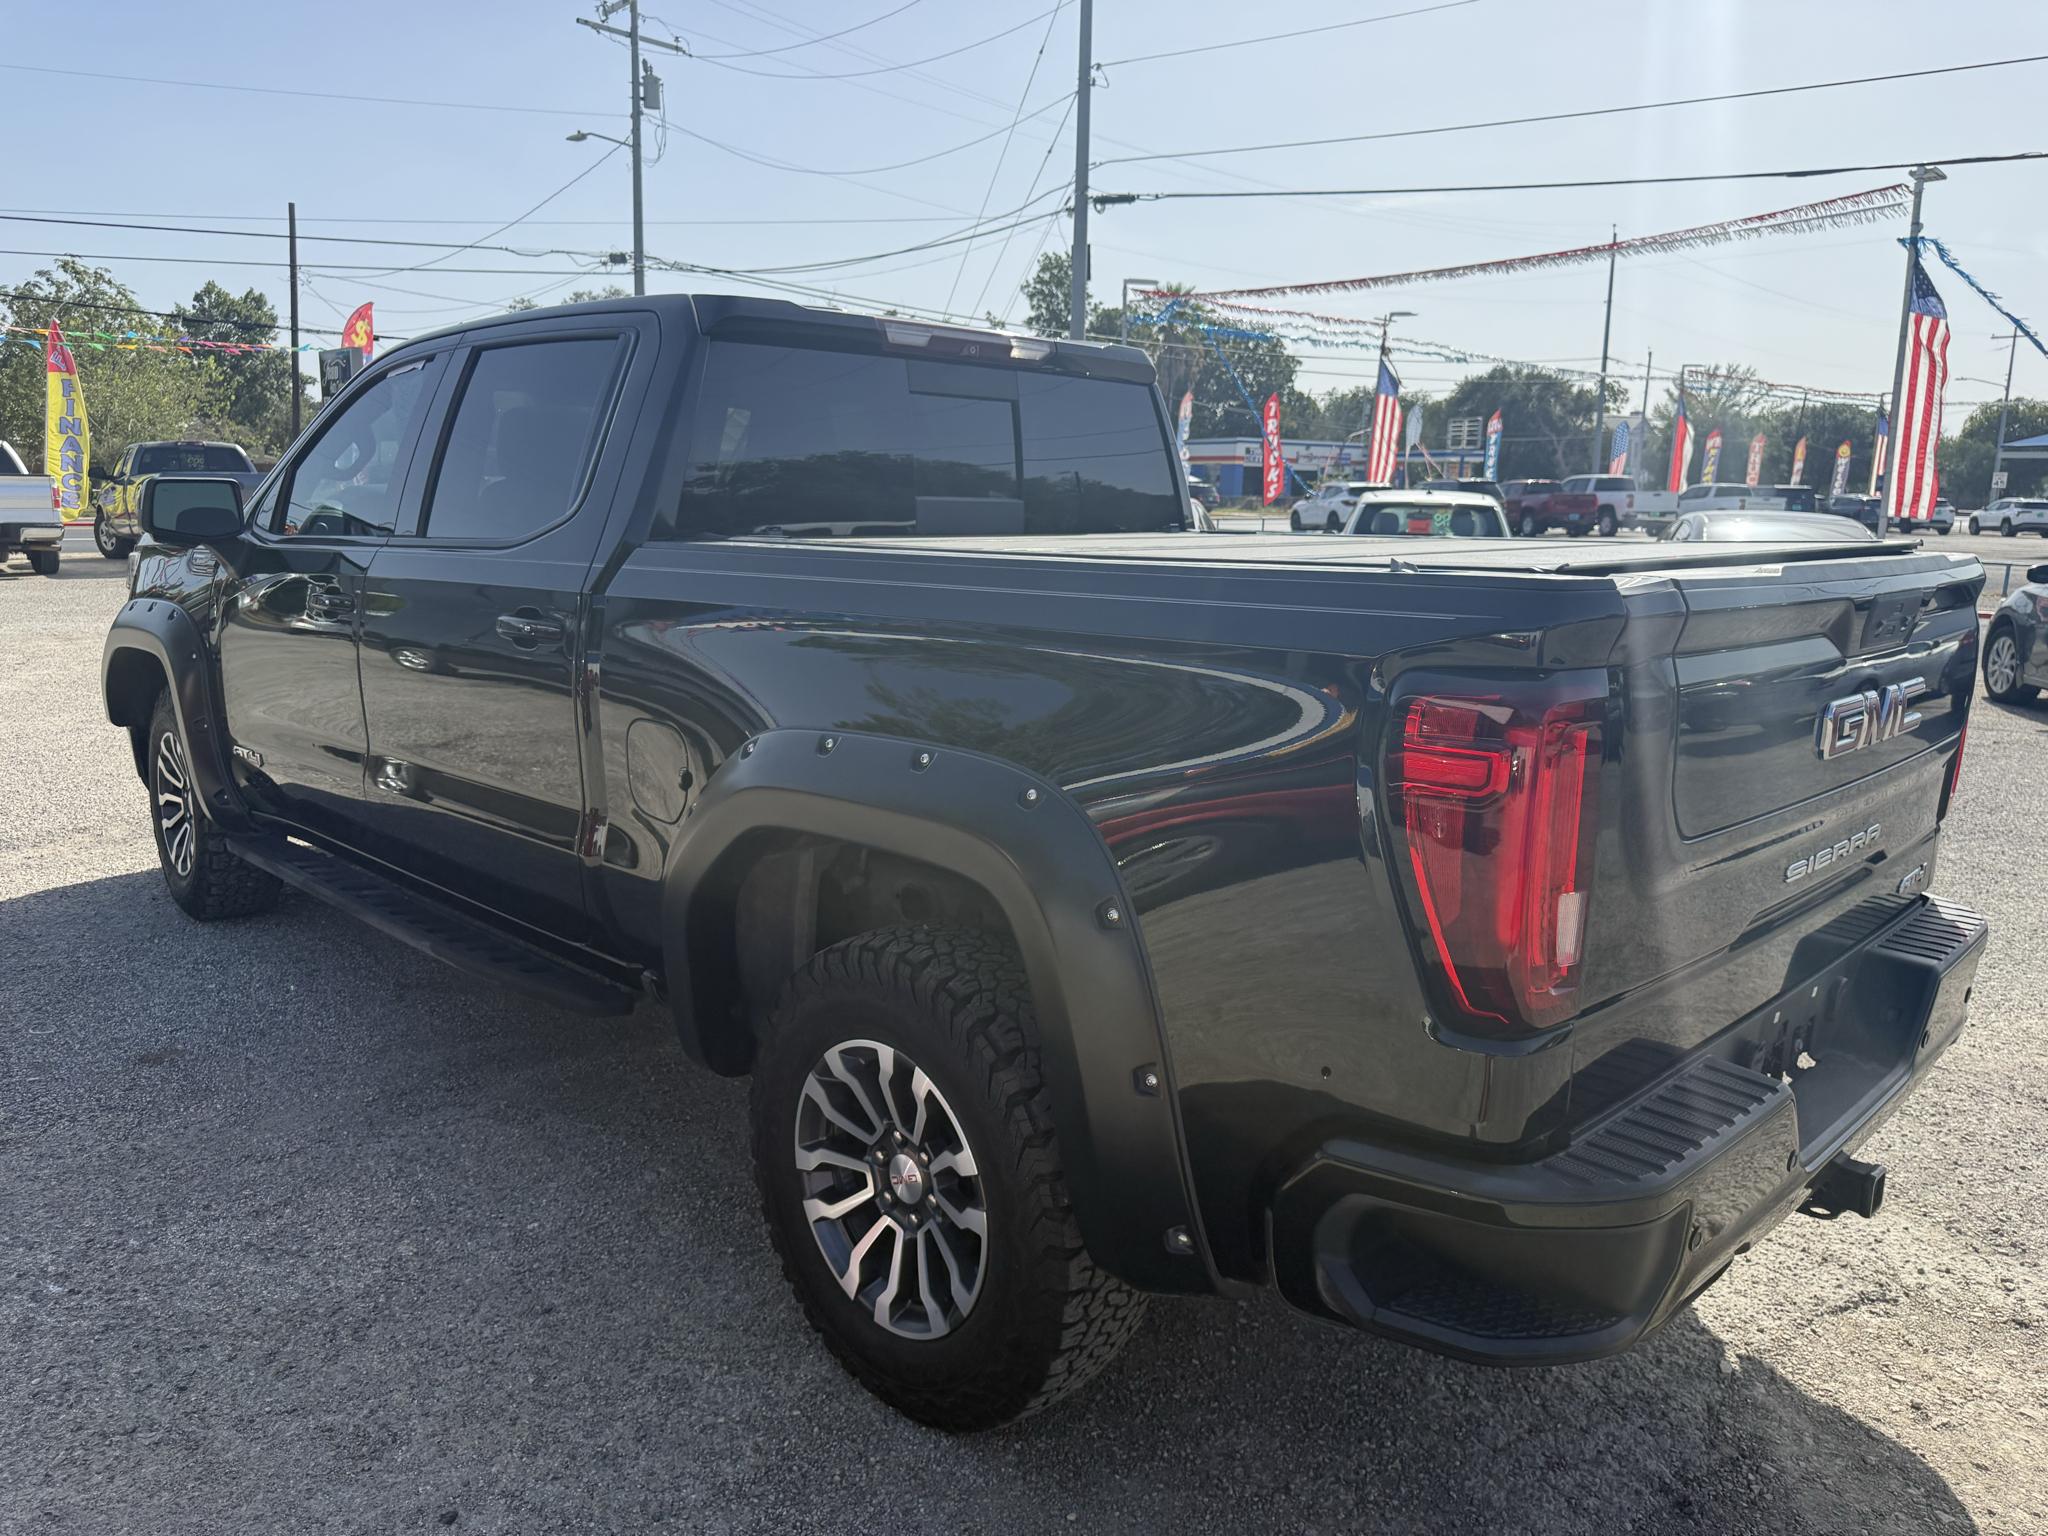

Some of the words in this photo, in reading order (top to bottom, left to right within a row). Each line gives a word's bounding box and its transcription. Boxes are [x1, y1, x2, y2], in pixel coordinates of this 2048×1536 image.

[59, 378, 84, 509] FINANCE
[1266, 401, 1280, 498] TRUCKS
[1820, 676, 1926, 760] GMC
[233, 745, 261, 768] AT4
[1784, 823, 1880, 884] SIERRA
[891, 1174, 918, 1185] GMC
